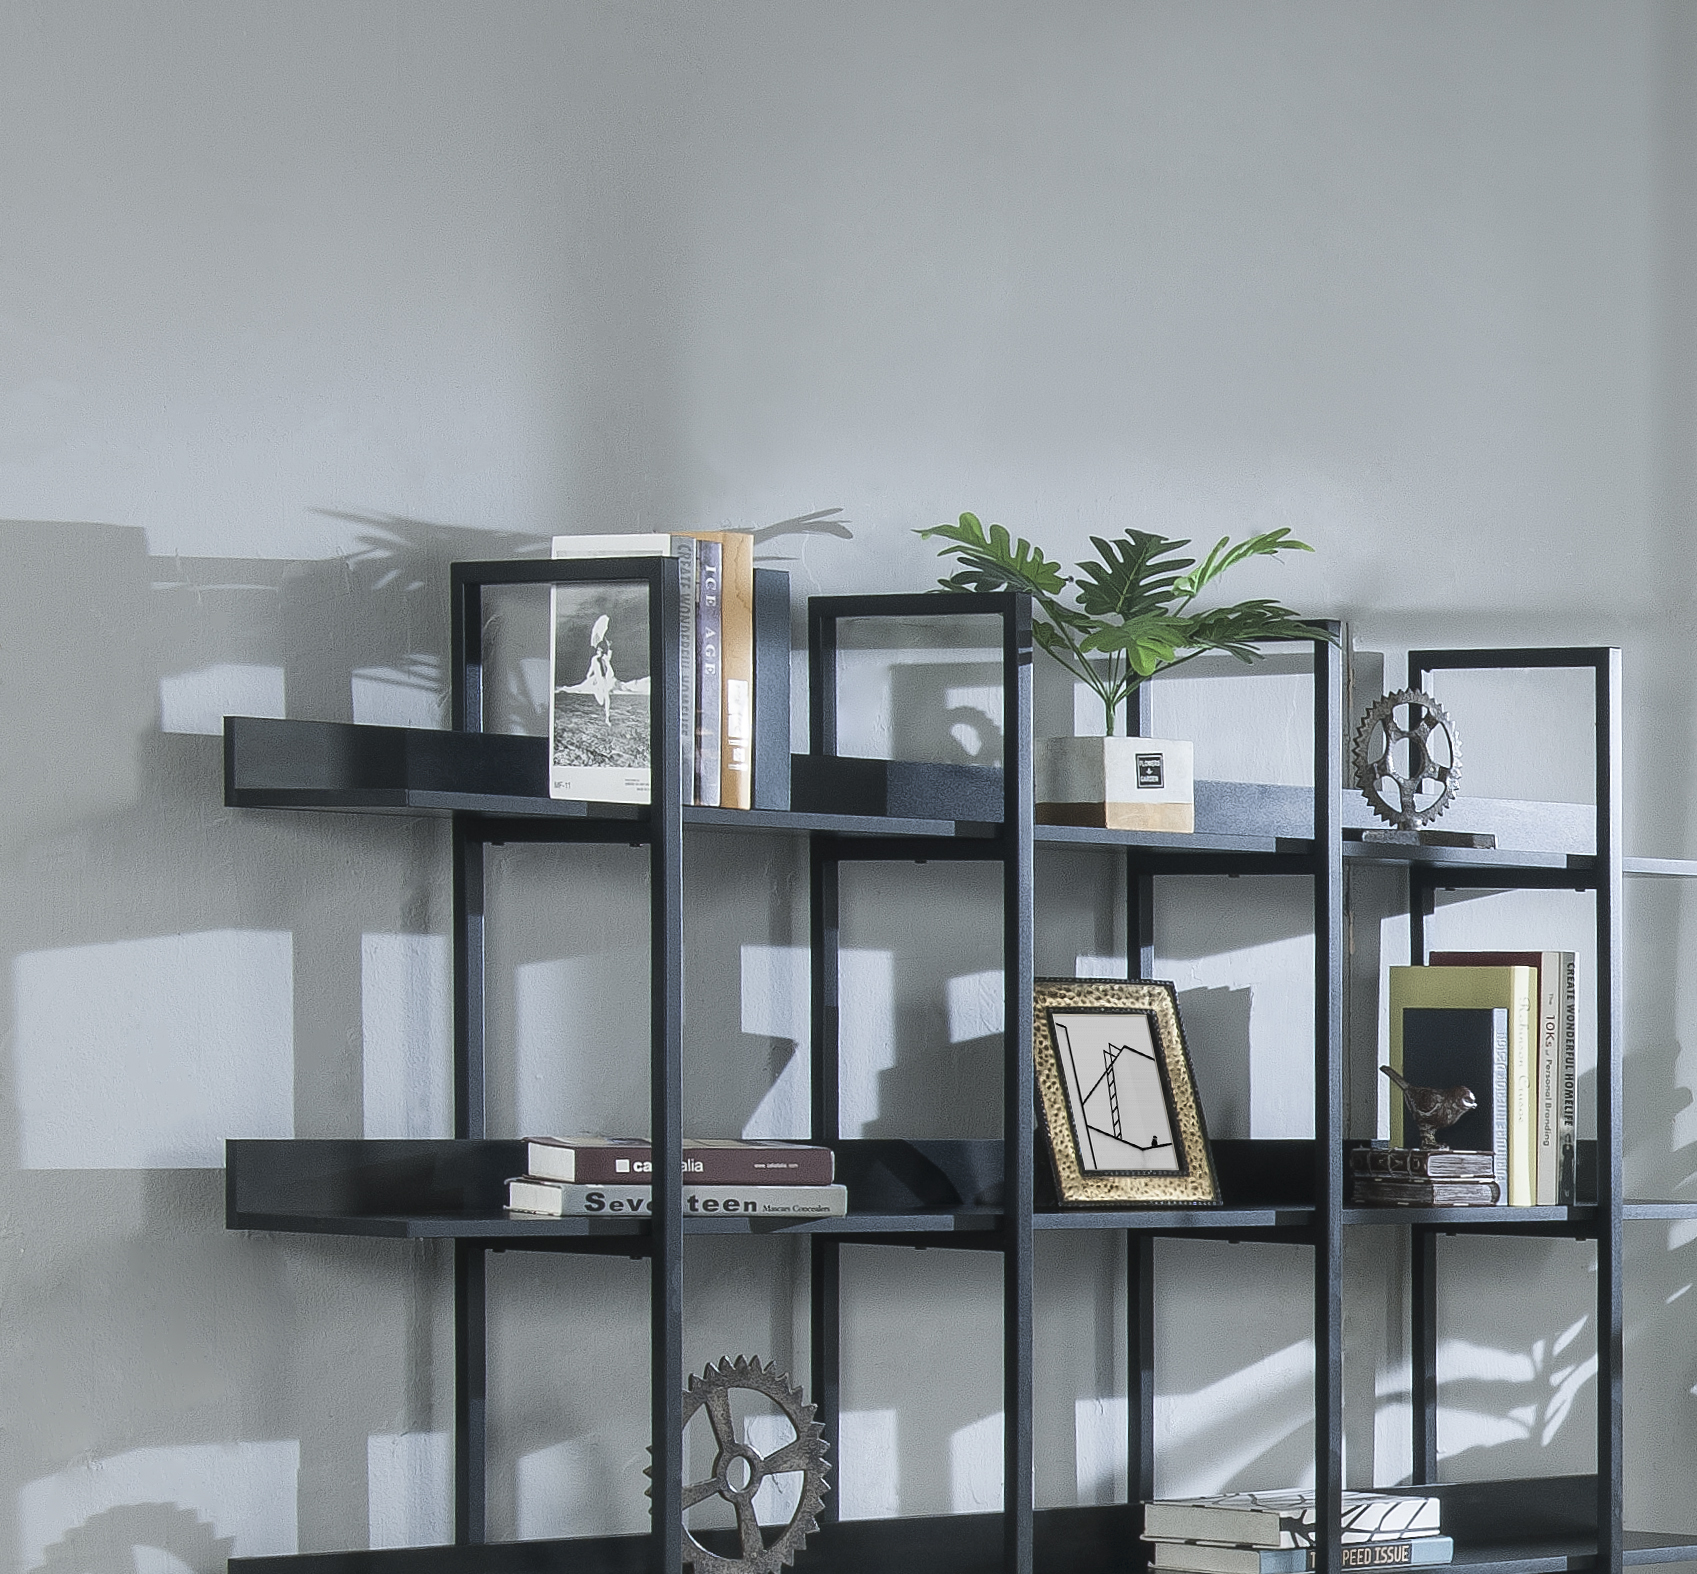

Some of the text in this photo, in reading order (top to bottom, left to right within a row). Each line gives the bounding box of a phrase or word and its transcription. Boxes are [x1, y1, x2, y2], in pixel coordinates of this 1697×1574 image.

[704, 565, 717, 675] ICE AGE
[1564, 962, 1576, 1127] CREATE WONDERFUL HOMELIFE
[1545, 1059, 1553, 1101] Personal
[1543, 1102, 1552, 1147] Branding
[584, 1192, 757, 1212] Sevteen
[1342, 1545, 1410, 1566] PEED ISSUE
